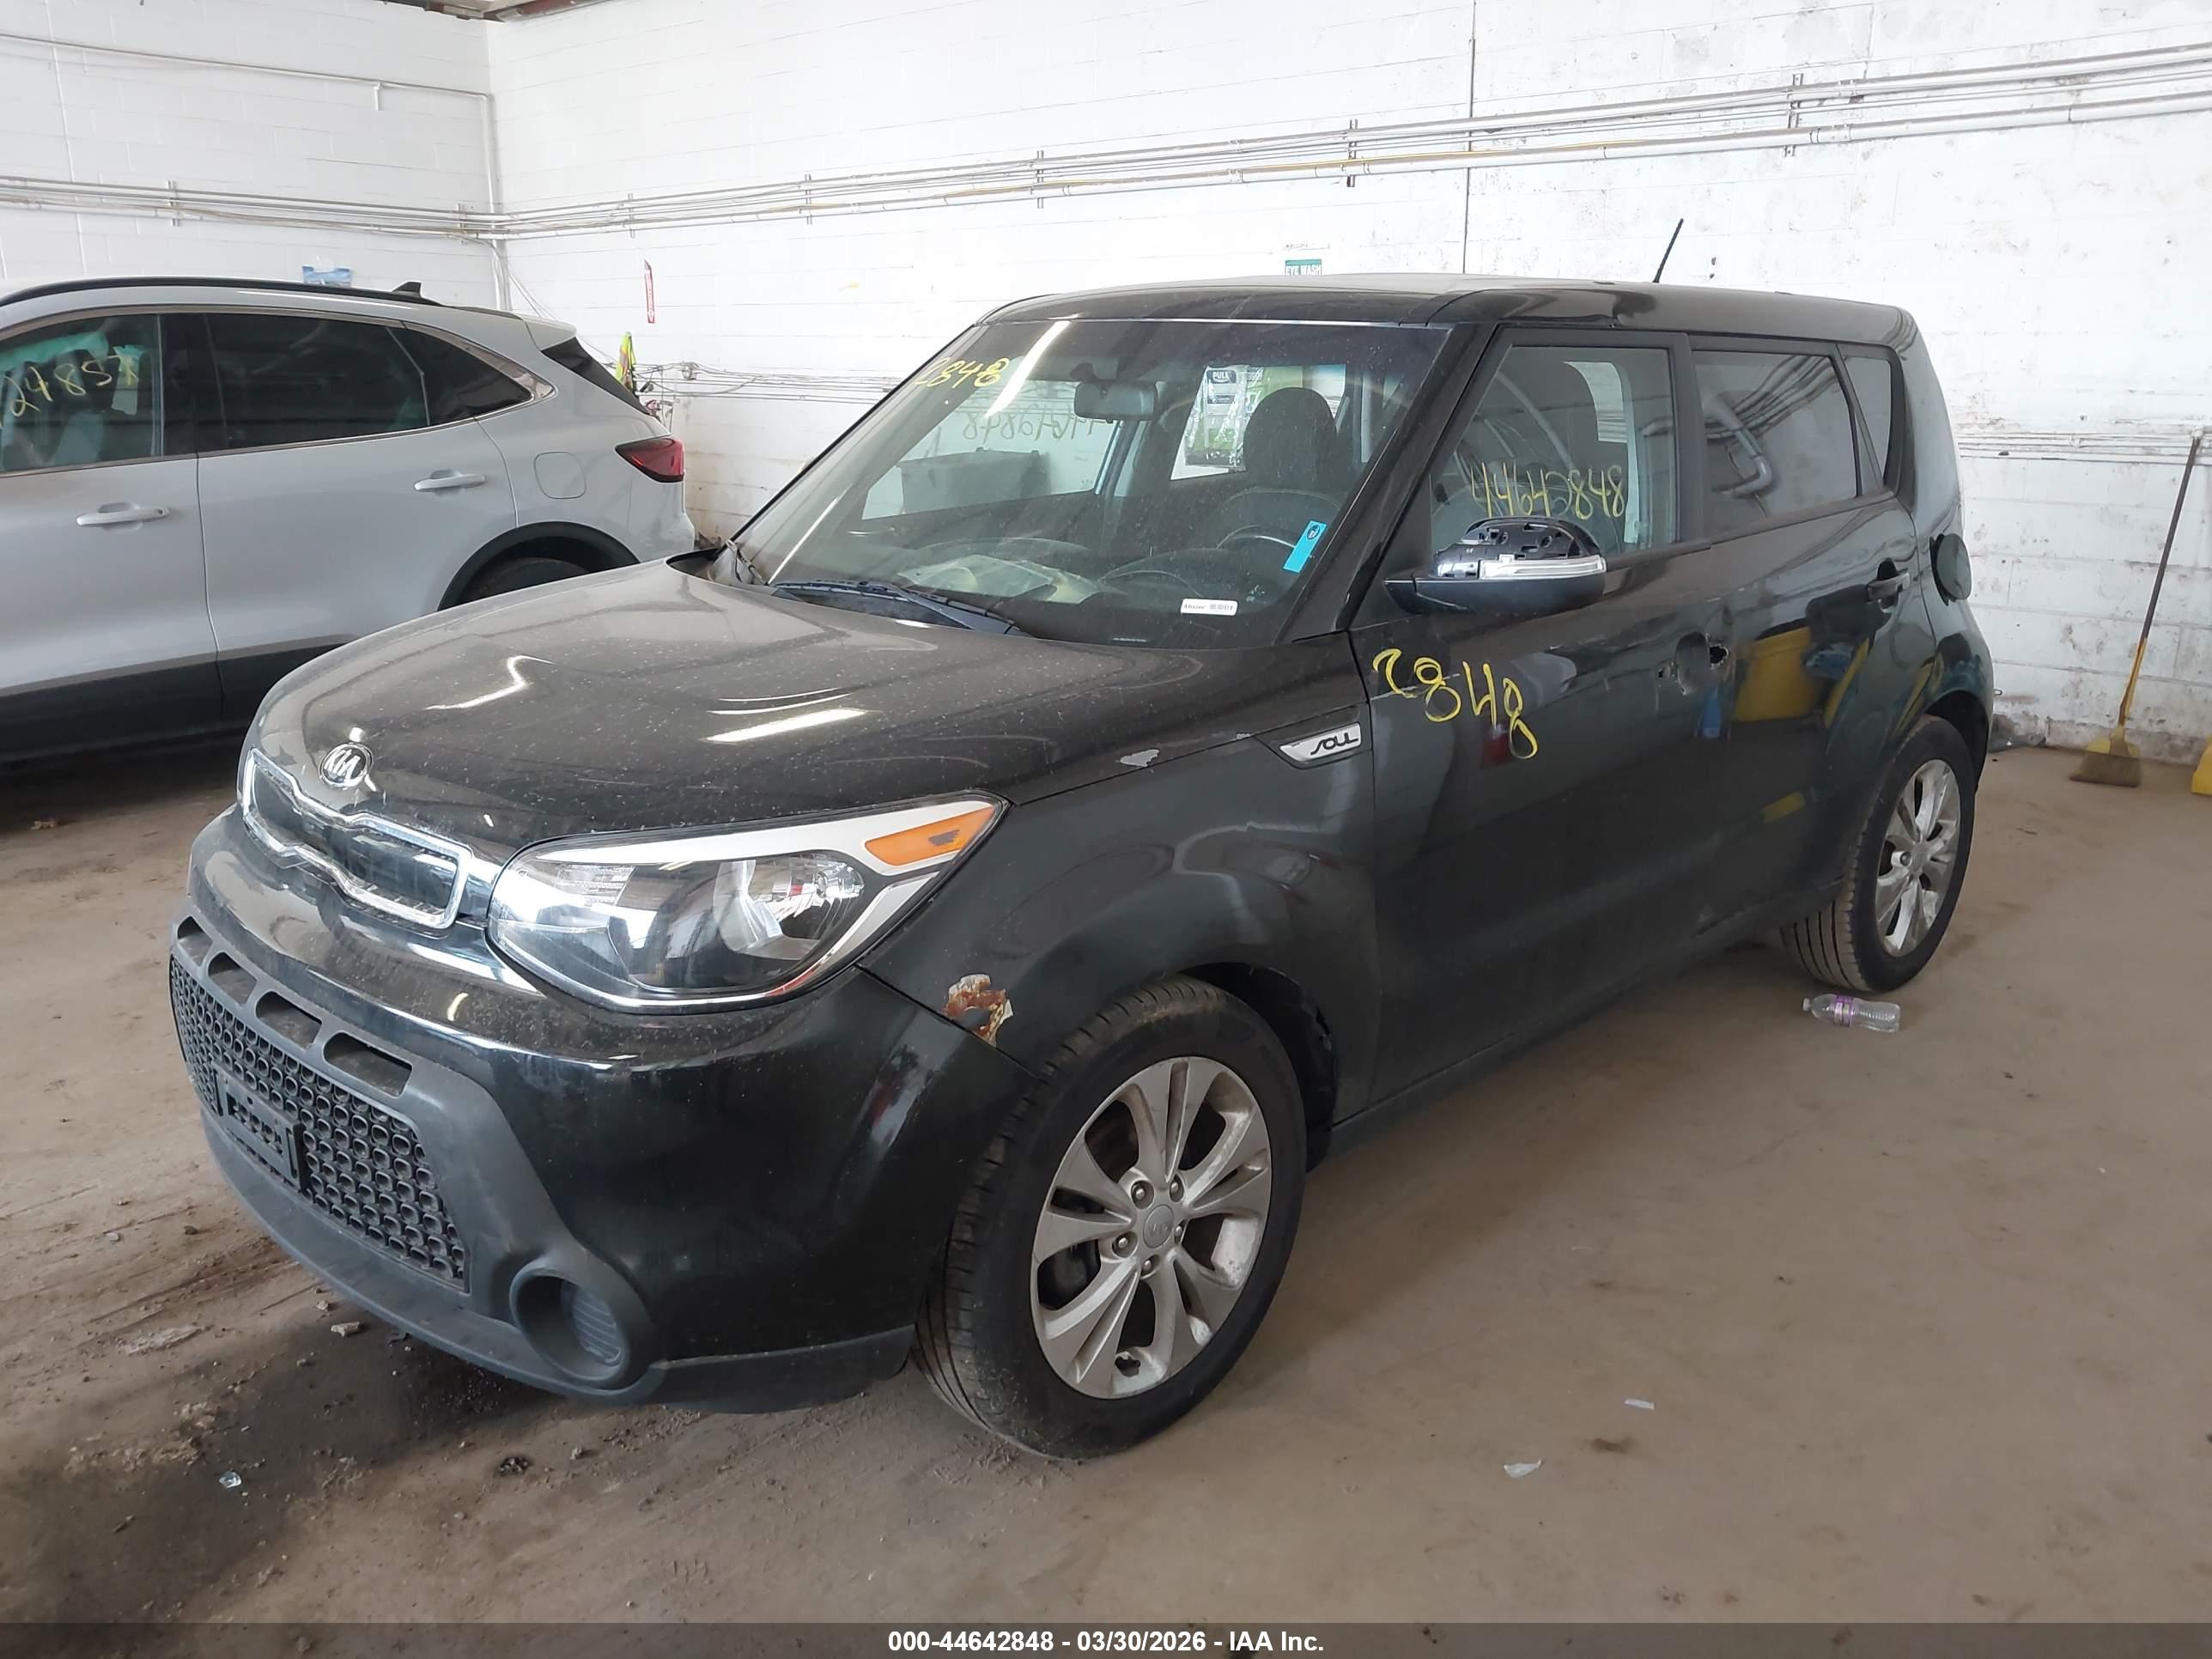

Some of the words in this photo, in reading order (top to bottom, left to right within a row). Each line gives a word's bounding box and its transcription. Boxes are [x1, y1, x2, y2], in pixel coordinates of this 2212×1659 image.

[1285, 265, 1300, 275] EYE
[1301, 264, 1322, 275] WASH
[915, 356, 1010, 389] 2848
[1212, 371, 1230, 380] PULL
[1470, 460, 1625, 520] 44642848
[1372, 647, 1539, 760] 2848
[1310, 732, 1358, 756] SOUL
